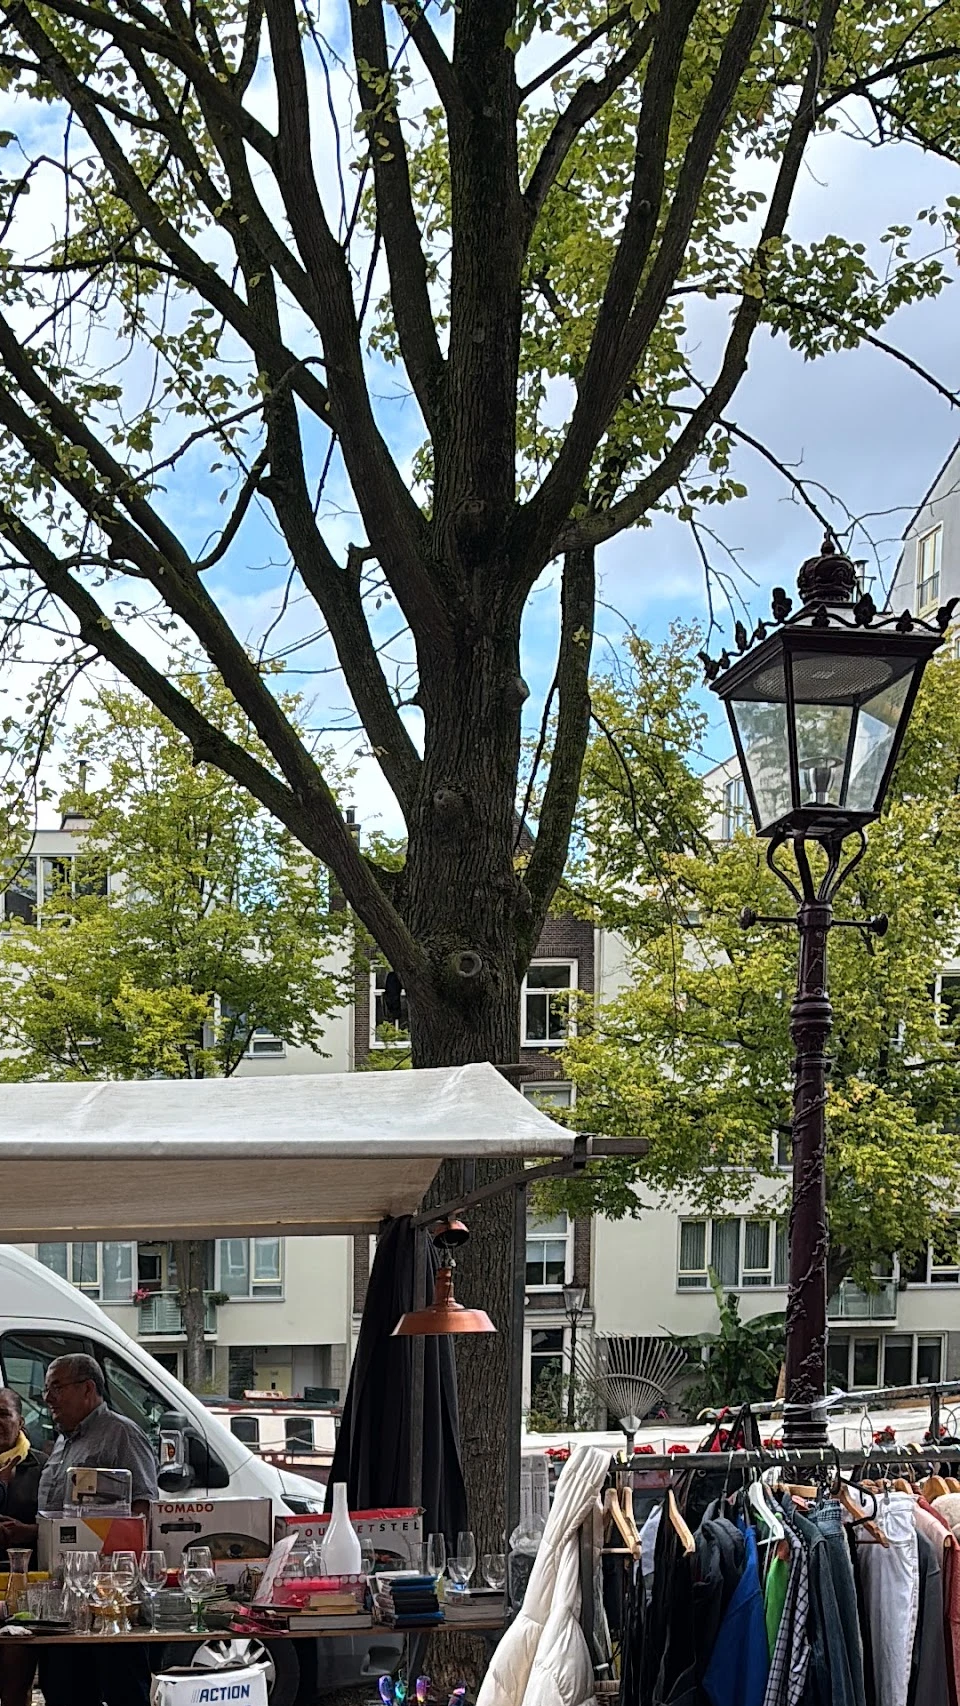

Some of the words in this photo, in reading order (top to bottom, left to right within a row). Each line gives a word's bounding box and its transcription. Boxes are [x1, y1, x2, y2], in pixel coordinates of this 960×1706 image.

[157, 1503, 214, 1514] TOMADO
[291, 1522, 420, 1537] OUETSTEL
[199, 1684, 250, 1703] ACTION
